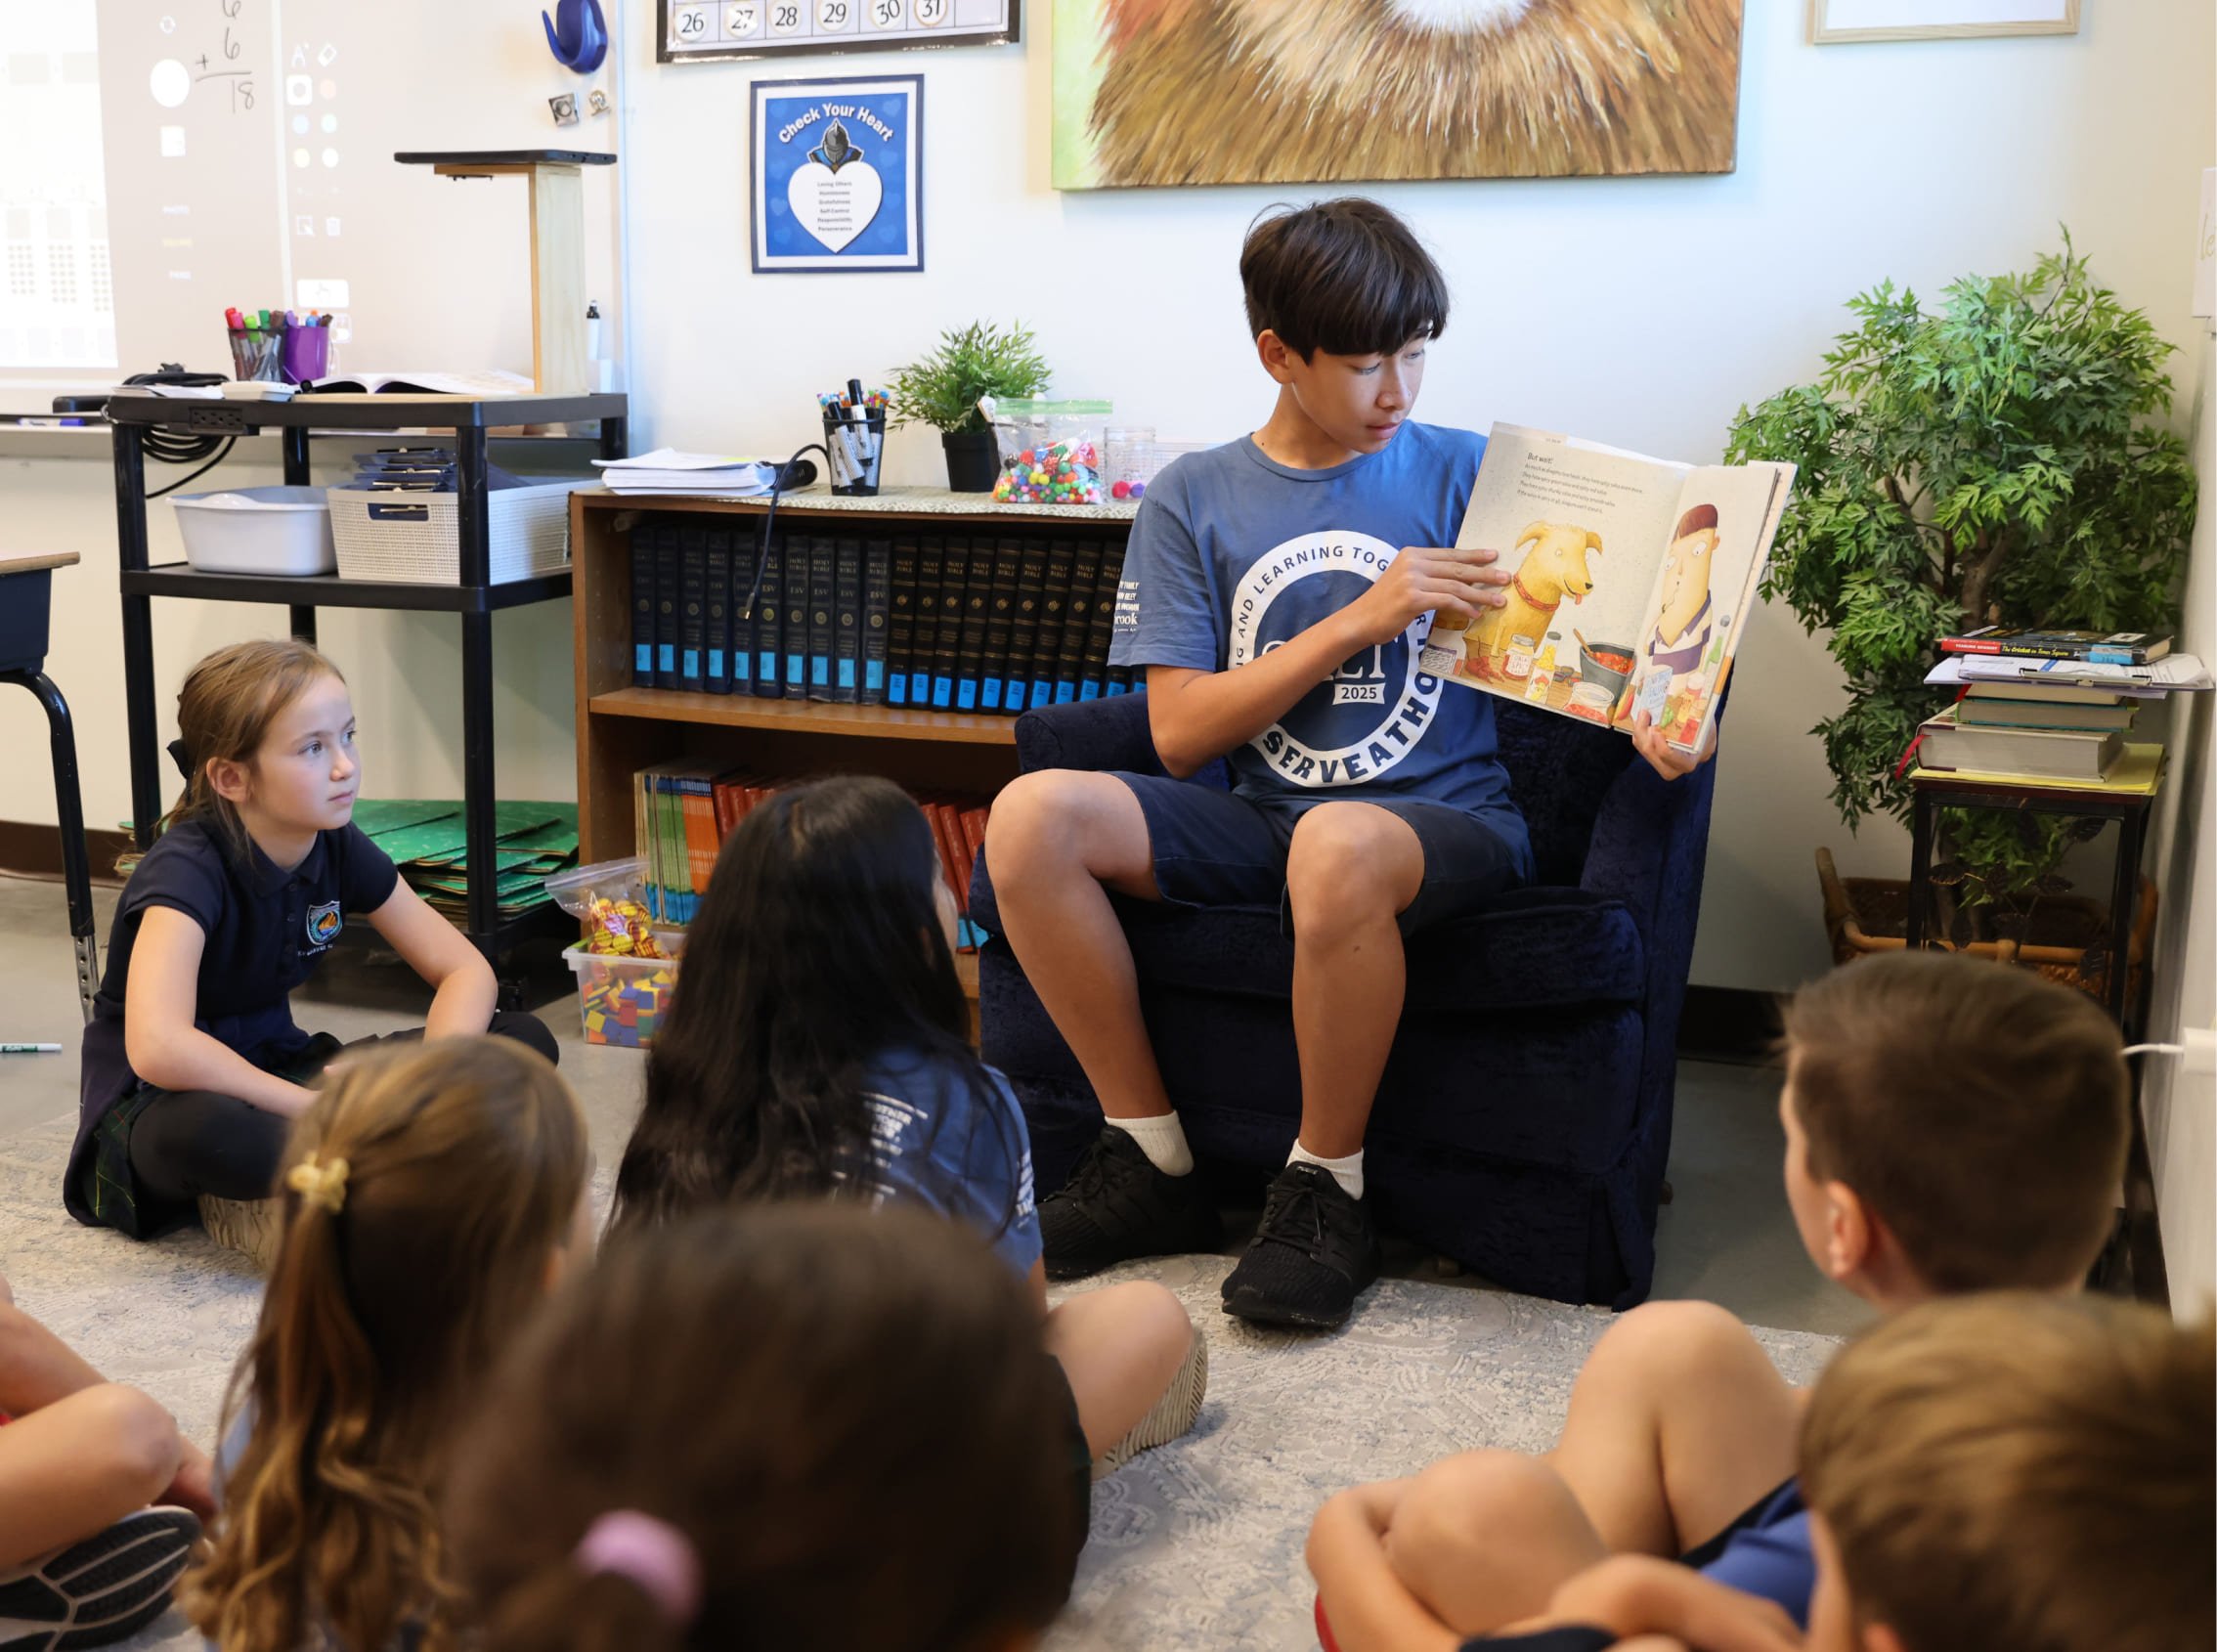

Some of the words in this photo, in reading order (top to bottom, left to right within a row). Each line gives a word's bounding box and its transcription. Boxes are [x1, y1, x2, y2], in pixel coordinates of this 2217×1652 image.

[681, 13, 705, 33] 26
[731, 10, 754, 30] 27
[775, 6, 798, 26] 28
[824, 3, 847, 23] 29
[877, 0, 900, 25] 30
[922, 0, 941, 18] 31
[225, 26, 240, 60] 6
[231, 79, 254, 113] 18
[779, 108, 821, 144] Check
[822, 102, 855, 118] Your
[857, 106, 894, 142] Heart
[1527, 452, 1539, 462] But
[1238, 598, 1254, 639] AND
[1253, 545, 1344, 594] LEARNING
[2052, 647, 2069, 657] Square
[1341, 686, 1377, 700] 2025
[1263, 638, 1438, 783] SERVEATHO
